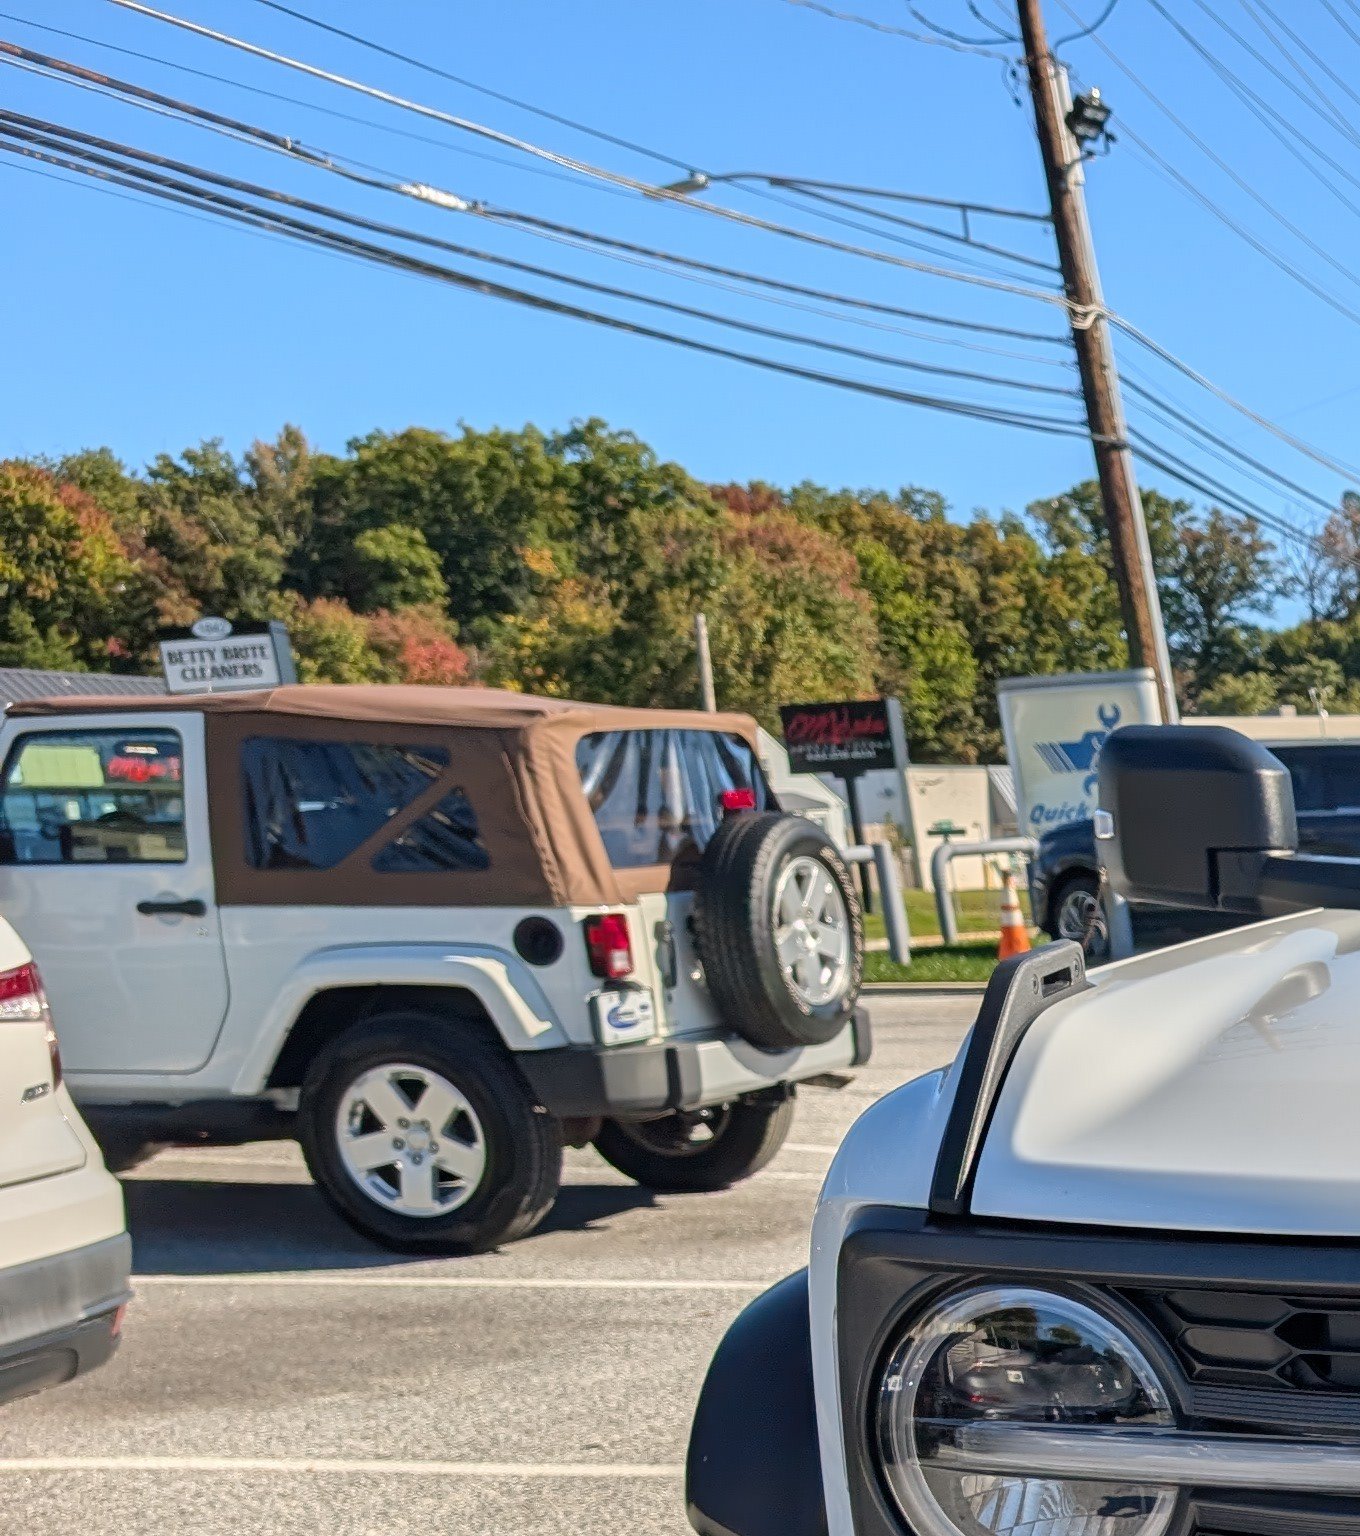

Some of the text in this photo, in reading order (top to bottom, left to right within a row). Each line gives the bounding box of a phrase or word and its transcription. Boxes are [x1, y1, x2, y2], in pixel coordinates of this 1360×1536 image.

[167, 644, 268, 665] BETTY BRITE
[181, 662, 263, 682] CLEANERS
[1030, 801, 1090, 825] Quick
